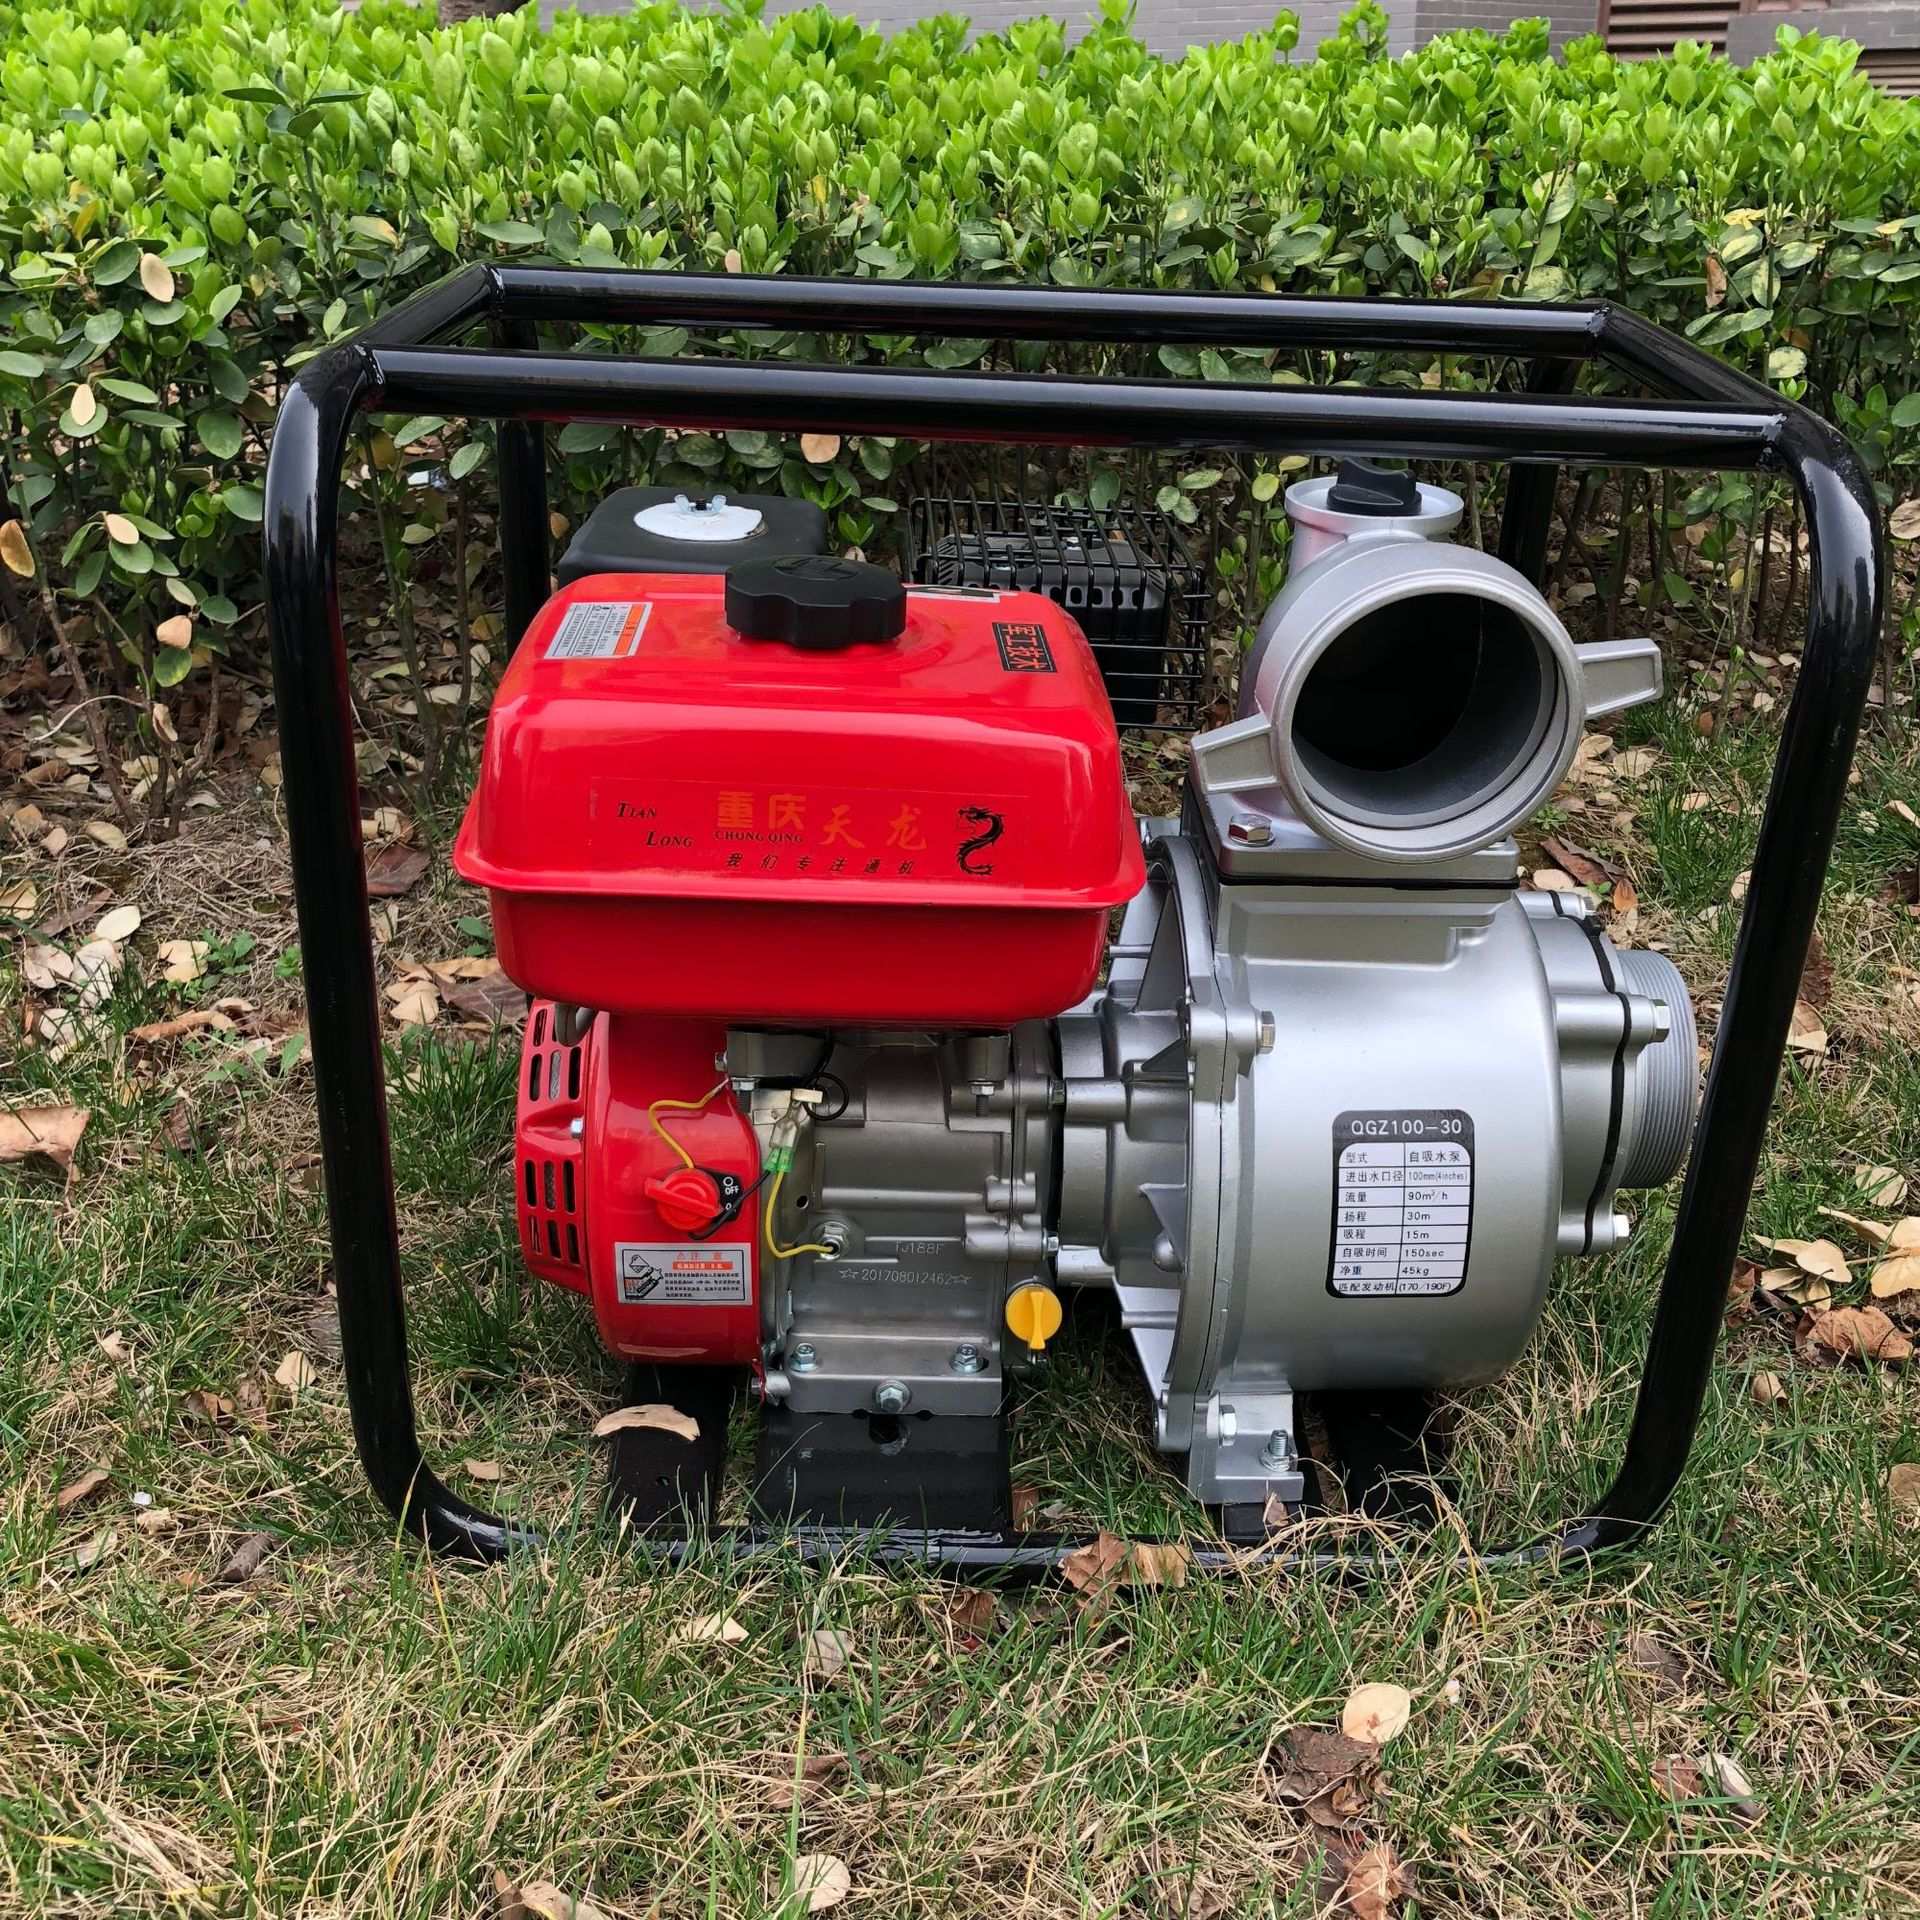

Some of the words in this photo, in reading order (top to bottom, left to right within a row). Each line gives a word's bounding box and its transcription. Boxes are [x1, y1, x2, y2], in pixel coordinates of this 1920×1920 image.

[1005, 624, 1048, 670] 军工技术
[617, 800, 657, 819] TIAN
[645, 831, 695, 848] LONG
[714, 831, 763, 842] CHONG
[768, 833, 804, 844] QING
[1351, 1118, 1463, 1136] QGZ100-30
[1345, 1151, 1369, 1165] 型式
[1409, 1150, 1462, 1164] 自吸水泵
[1345, 1171, 1404, 1184] 进出水口径
[724, 1185, 740, 1196] OFF
[1344, 1191, 1368, 1204] 流量
[1344, 1210, 1368, 1223] 扬程
[1407, 1211, 1431, 1222] 30m
[1343, 1228, 1367, 1240] 吸程
[1406, 1229, 1430, 1240] 15m
[1342, 1246, 1388, 1259] 自吸时间
[1405, 1247, 1446, 1258] 150sec
[1339, 1264, 1363, 1276] 净重
[1401, 1264, 1430, 1277] 45kg
[1338, 1281, 1395, 1293] 匹配发动机
[1398, 1280, 1453, 1293] (170/190F)
